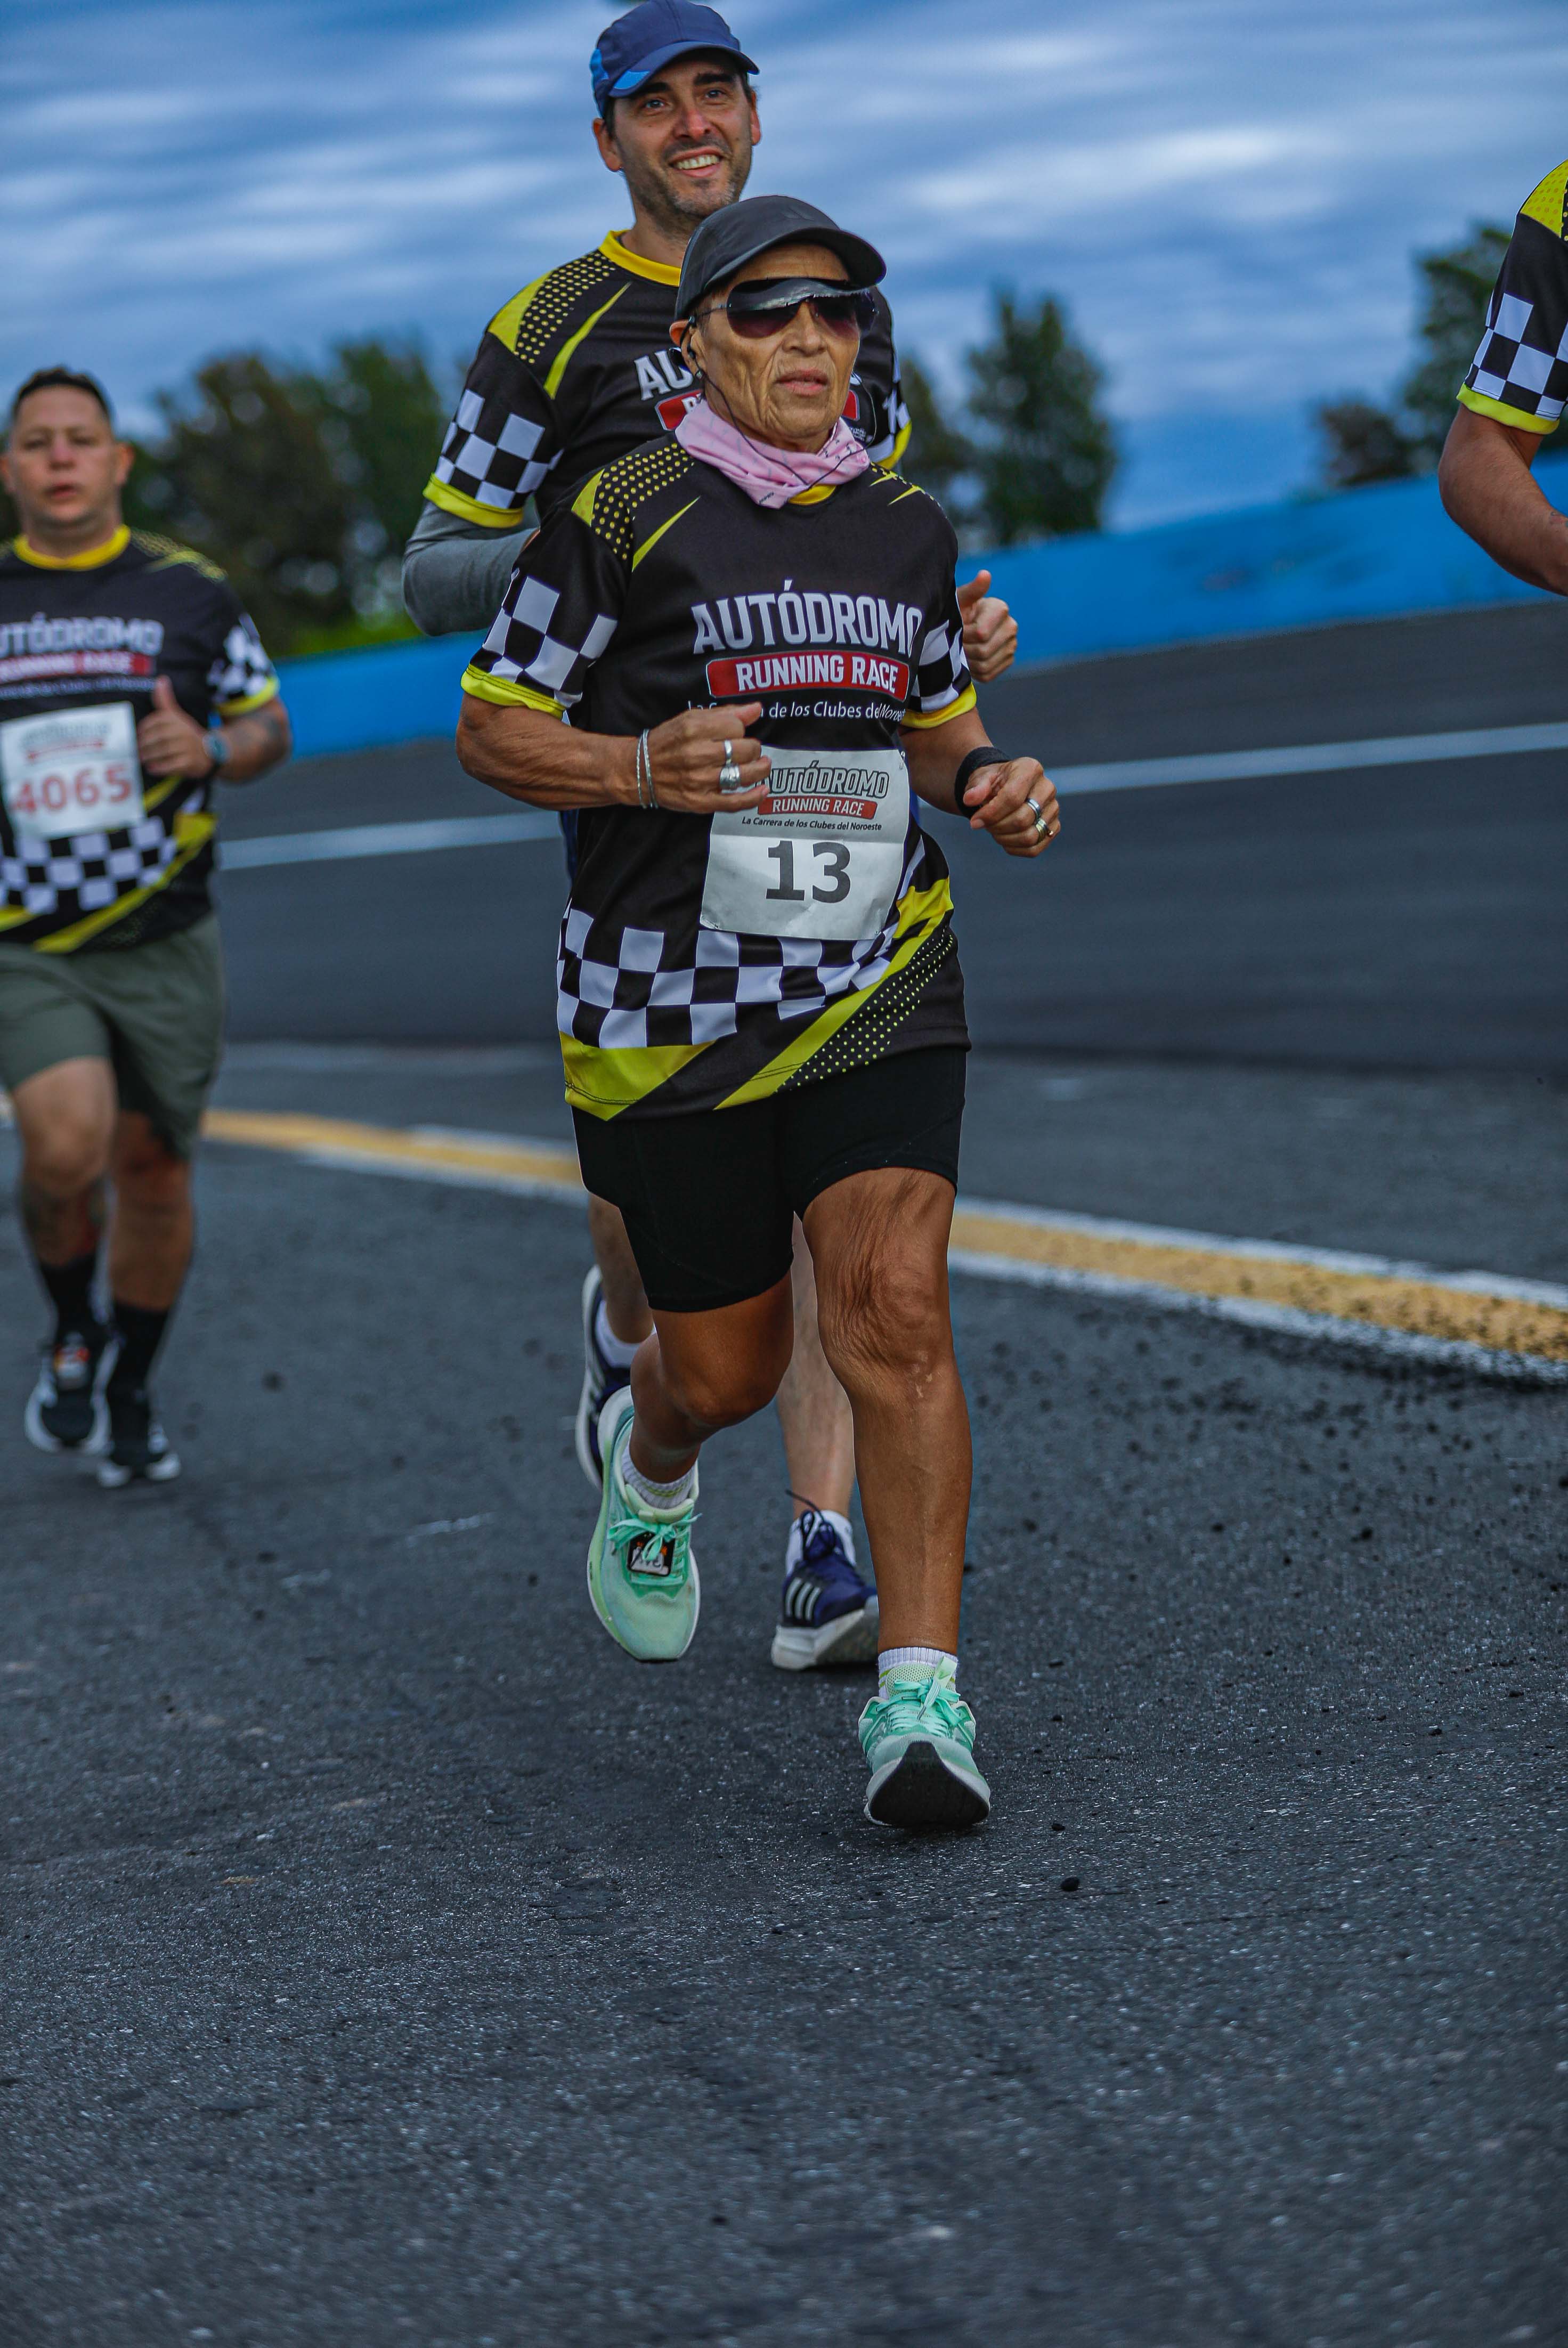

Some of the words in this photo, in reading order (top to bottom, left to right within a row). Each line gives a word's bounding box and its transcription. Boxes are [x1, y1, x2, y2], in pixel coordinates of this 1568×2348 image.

[692, 579, 922, 657] AUTÓDROMO
[736, 655, 844, 692] RUNNING
[851, 656, 898, 694] RACE
[769, 702, 786, 718] de
[791, 701, 810, 717] los
[814, 701, 862, 718] Clubes
[11, 765, 132, 814] 4065
[772, 798, 830, 813] RUNNING
[833, 802, 865, 816] RACE
[753, 818, 782, 826] Carrera
[809, 820, 835, 830] Clubes
[837, 822, 849, 830] del
[850, 823, 882, 831] Noroeste
[766, 840, 851, 904] 13
